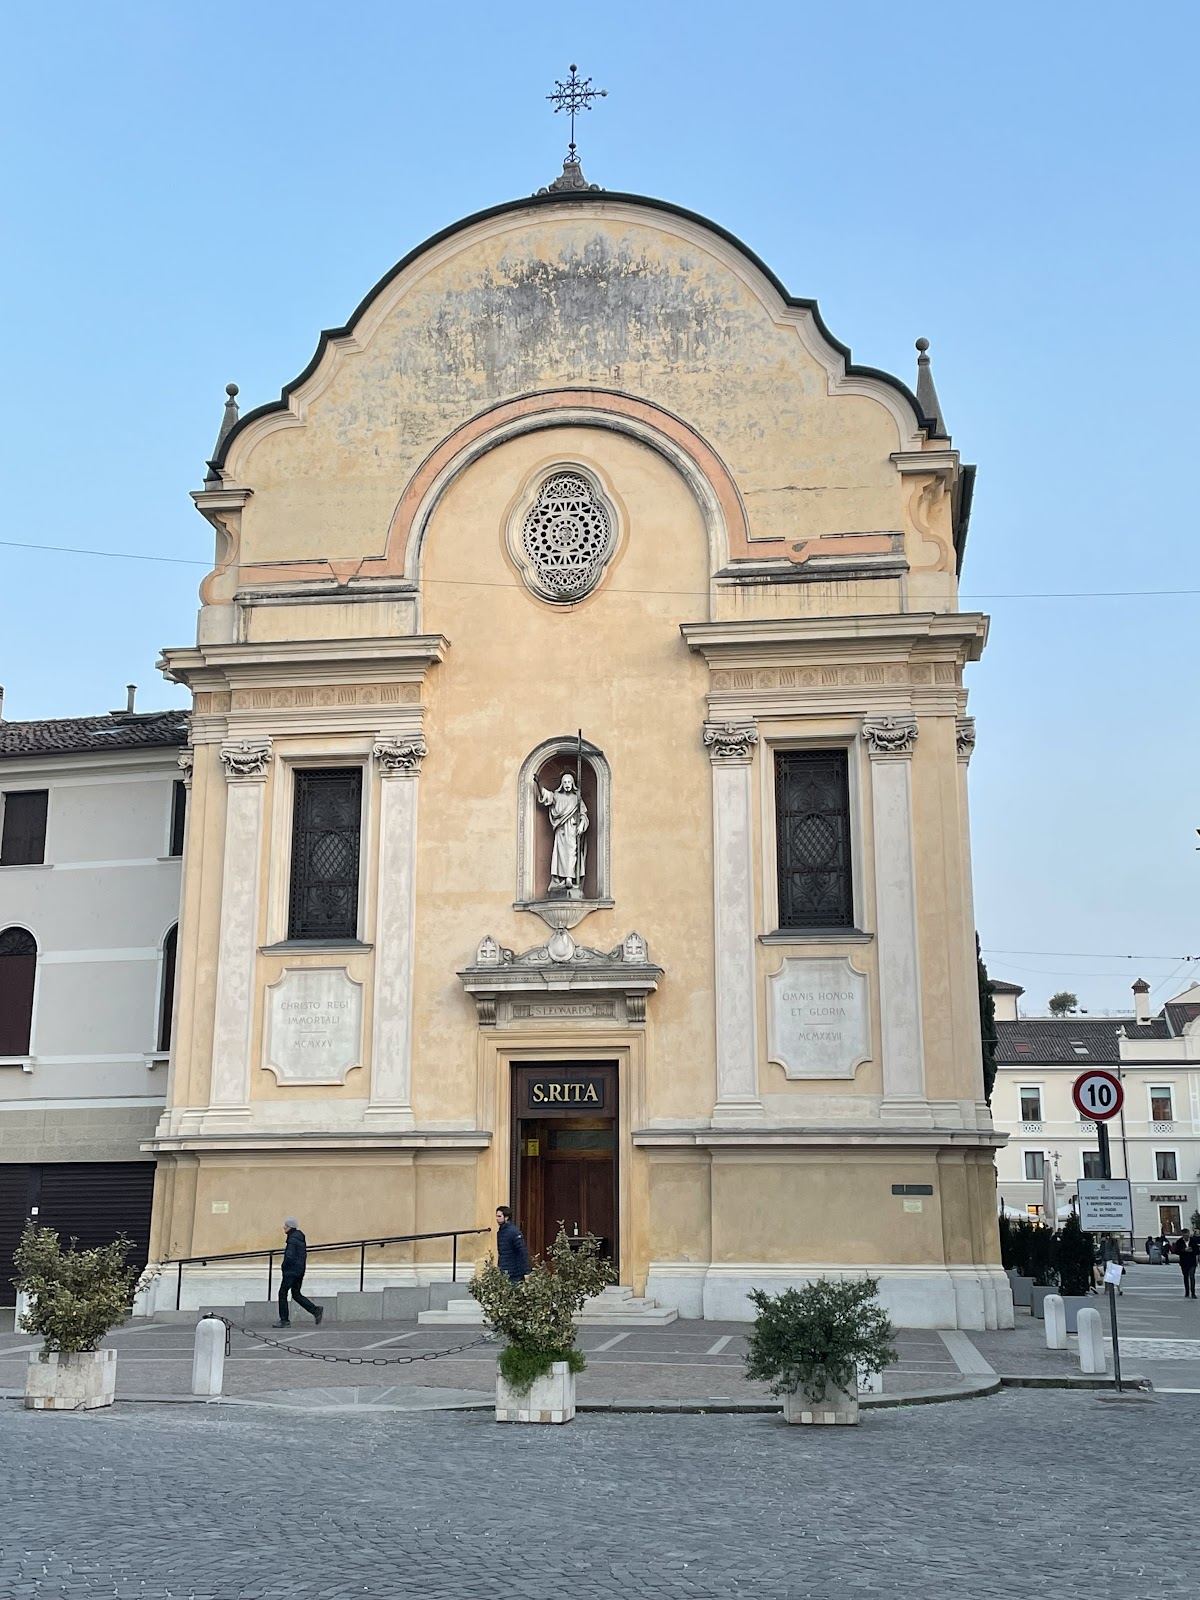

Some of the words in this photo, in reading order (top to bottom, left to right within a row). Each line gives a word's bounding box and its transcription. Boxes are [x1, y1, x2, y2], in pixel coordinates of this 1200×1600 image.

[782, 992, 814, 1001] OMNIS
[818, 991, 855, 1000] HONOR
[280, 1001, 321, 1010] CHRISTO
[327, 1000, 349, 1009] REGI
[791, 1008, 802, 1017] ET
[809, 1007, 846, 1017] GLORIA
[288, 1016, 340, 1025] IMMORTALI
[798, 1032, 842, 1041] MCMXXVII
[532, 1082, 599, 1102] S.RITA
[1087, 1083, 1112, 1107] 10
